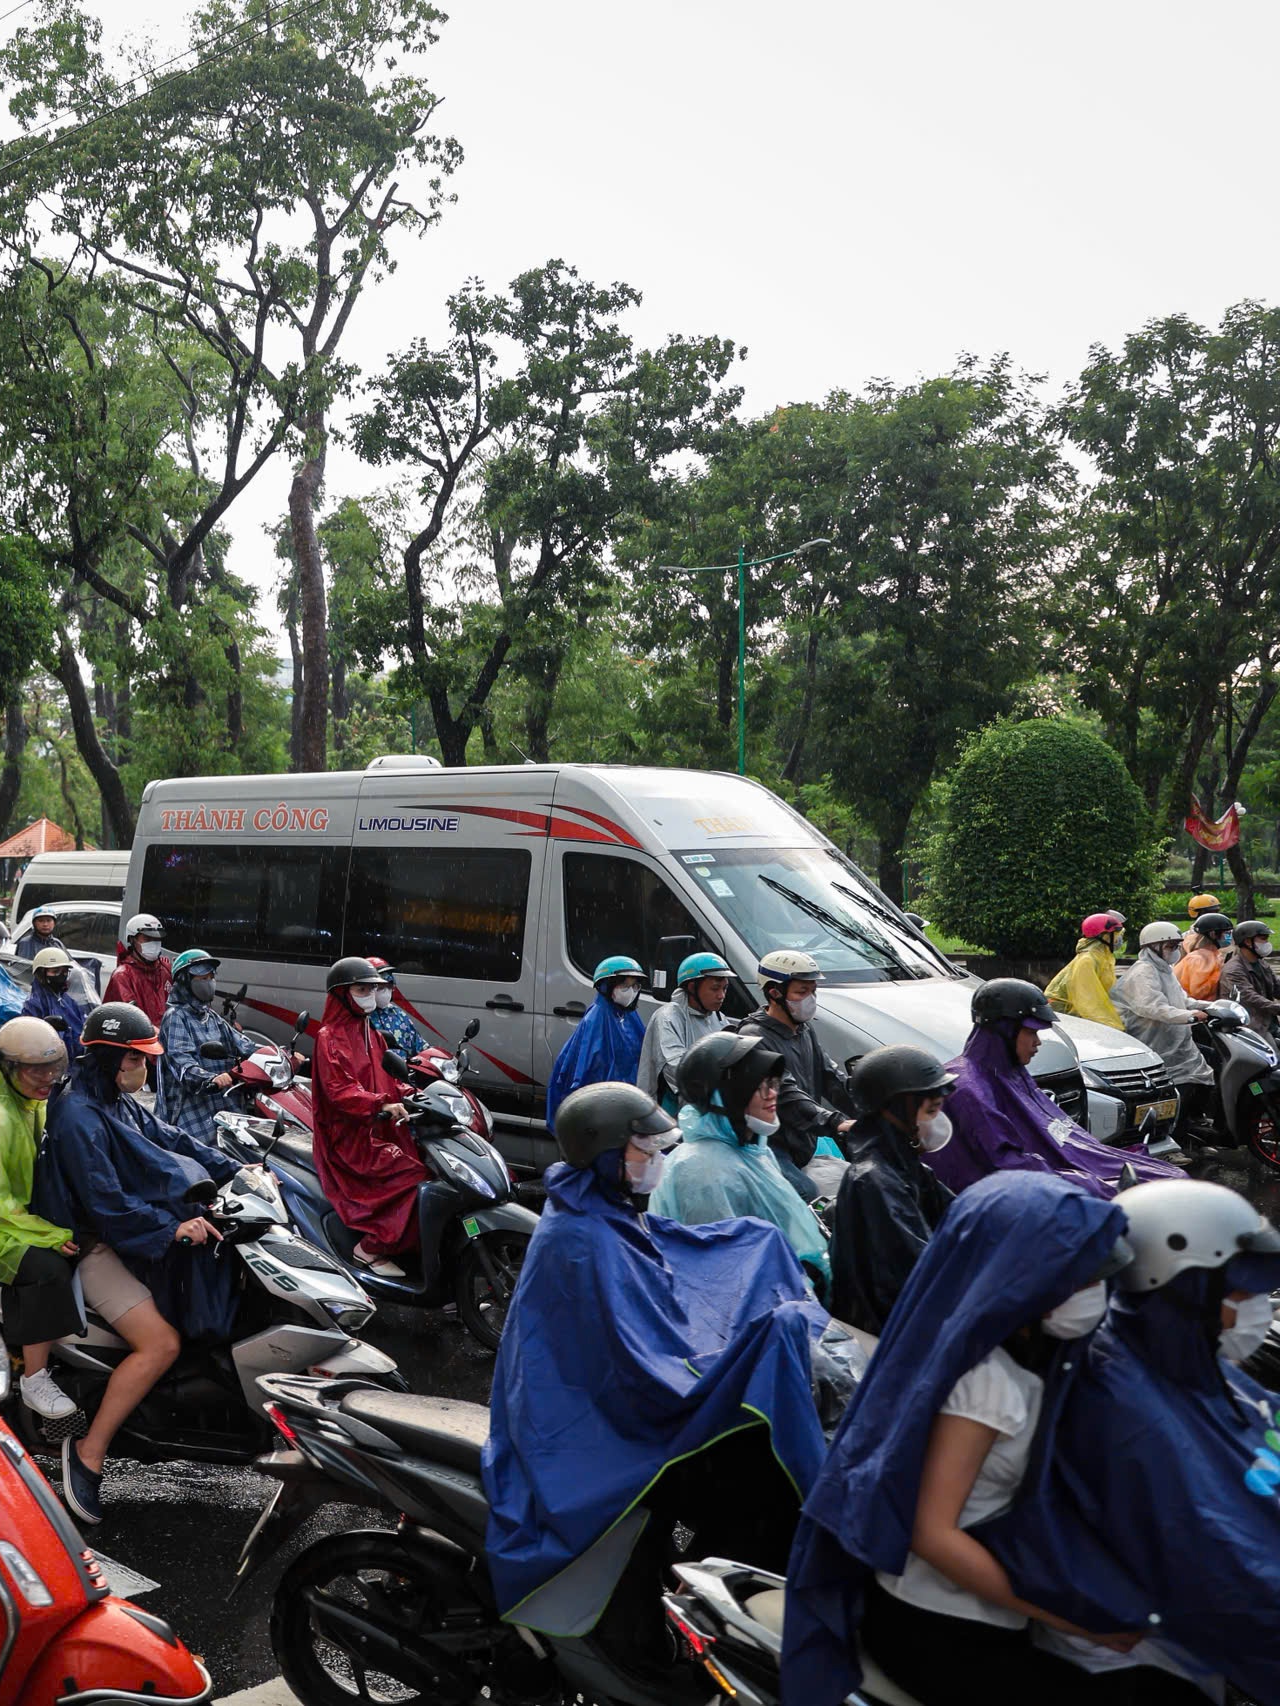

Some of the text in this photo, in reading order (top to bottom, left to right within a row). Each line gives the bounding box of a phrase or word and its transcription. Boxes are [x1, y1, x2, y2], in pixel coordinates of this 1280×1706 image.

[160, 802, 330, 832] THÀNH CÔNG
[357, 816, 460, 833] LIMOUSINE
[245, 1252, 299, 1292] 125
